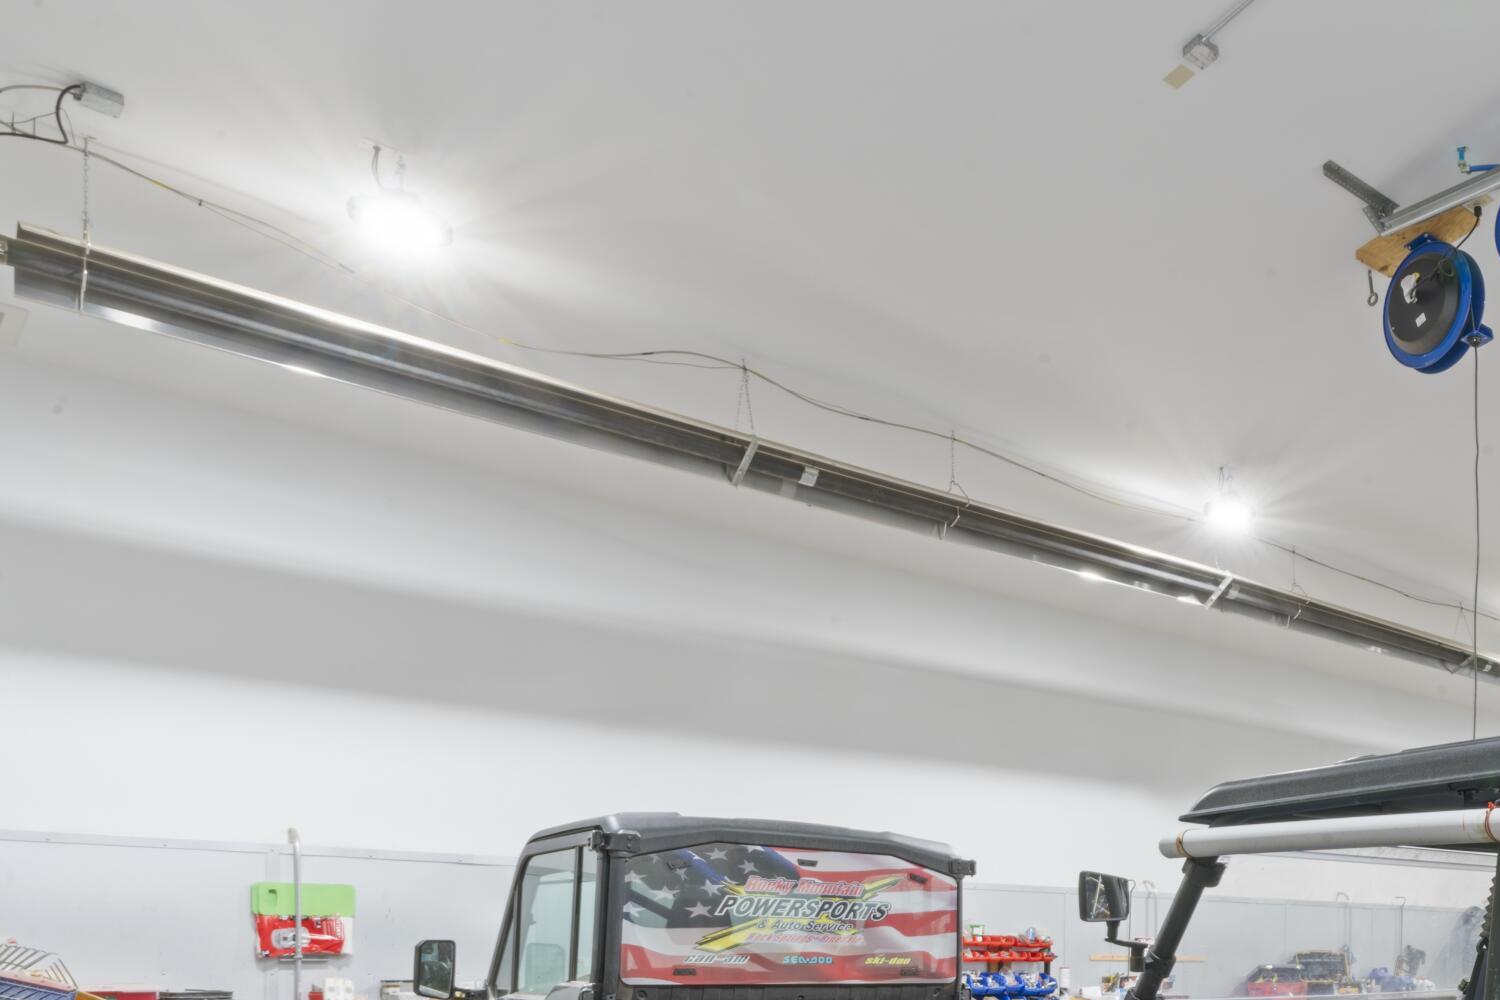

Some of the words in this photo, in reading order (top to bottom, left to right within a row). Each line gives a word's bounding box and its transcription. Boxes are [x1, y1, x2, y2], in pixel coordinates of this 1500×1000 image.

[745, 876, 797, 896] Rocky
[798, 879, 865, 898] Mountain
[715, 895, 891, 920] POWERSPORTS
[757, 919, 767, 929] &
[773, 920, 800, 930] Auto
[803, 921, 853, 932] Service
